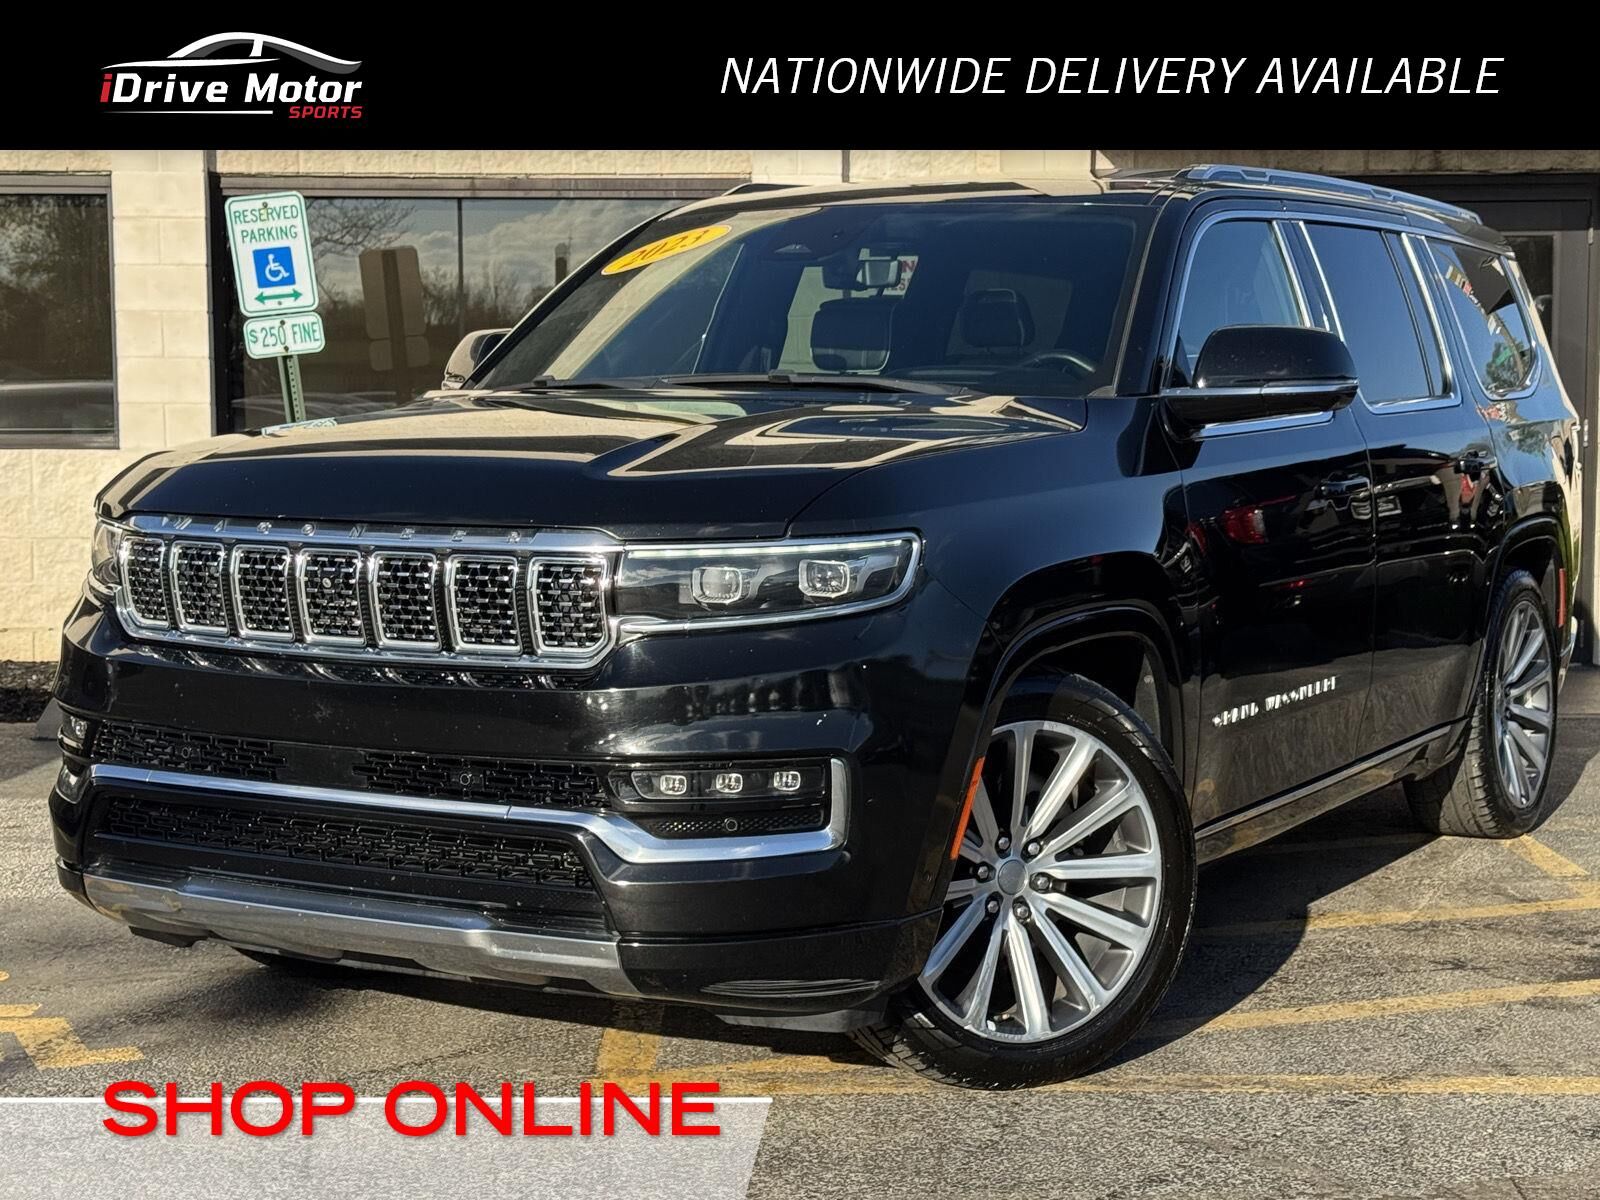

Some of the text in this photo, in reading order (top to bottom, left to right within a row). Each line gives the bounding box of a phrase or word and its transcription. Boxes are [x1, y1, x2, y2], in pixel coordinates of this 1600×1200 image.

[233, 203, 299, 225] RESERVED
[240, 225, 298, 243] PARKING
[292, 321, 320, 344] FINE
